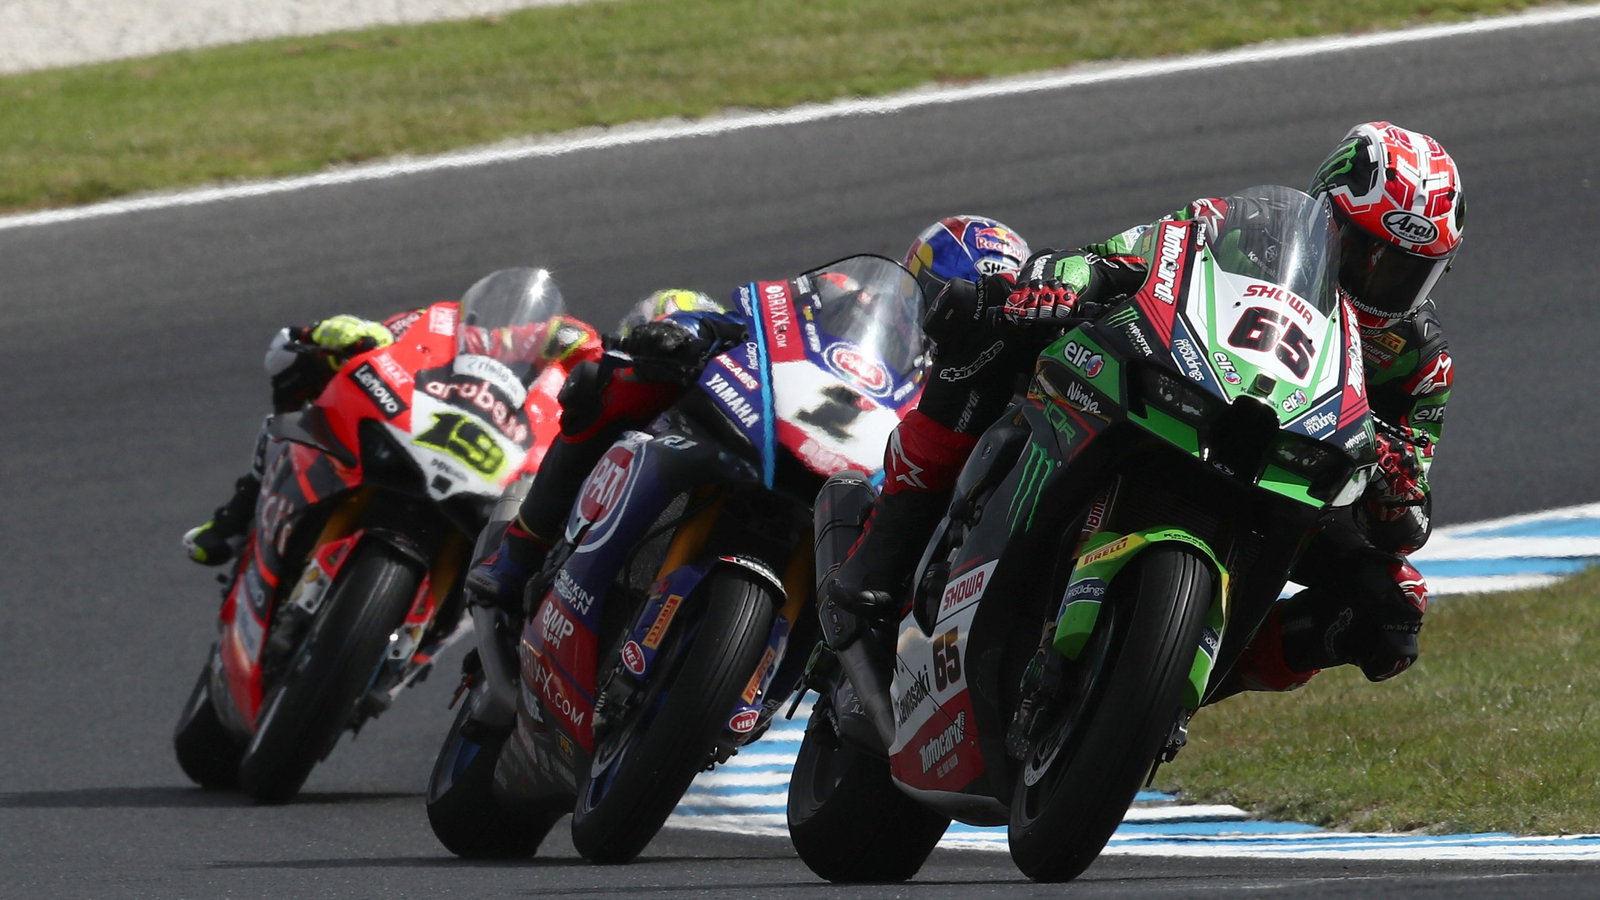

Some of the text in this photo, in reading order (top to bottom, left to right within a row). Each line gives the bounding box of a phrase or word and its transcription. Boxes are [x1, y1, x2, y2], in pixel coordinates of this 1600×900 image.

[976, 236, 1005, 252] Red
[1388, 215, 1433, 239] Arai
[1243, 284, 1314, 326] SHOWA
[1064, 341, 1088, 369] elf
[1128, 321, 1153, 357] MONSTER
[1227, 306, 1317, 381] 65
[1173, 339, 1205, 382] mouldings
[1214, 352, 1237, 373] elf
[354, 363, 399, 414] Lenovo
[705, 373, 760, 428] YAMAHA
[1066, 381, 1102, 414] Ninja
[1282, 393, 1299, 413] elf
[412, 411, 507, 479] 19
[1084, 537, 1128, 566] PIRELLI
[942, 571, 985, 612] SHOWA
[542, 601, 575, 641] BMP
[624, 646, 639, 671] HEL
[932, 625, 962, 693] 65
